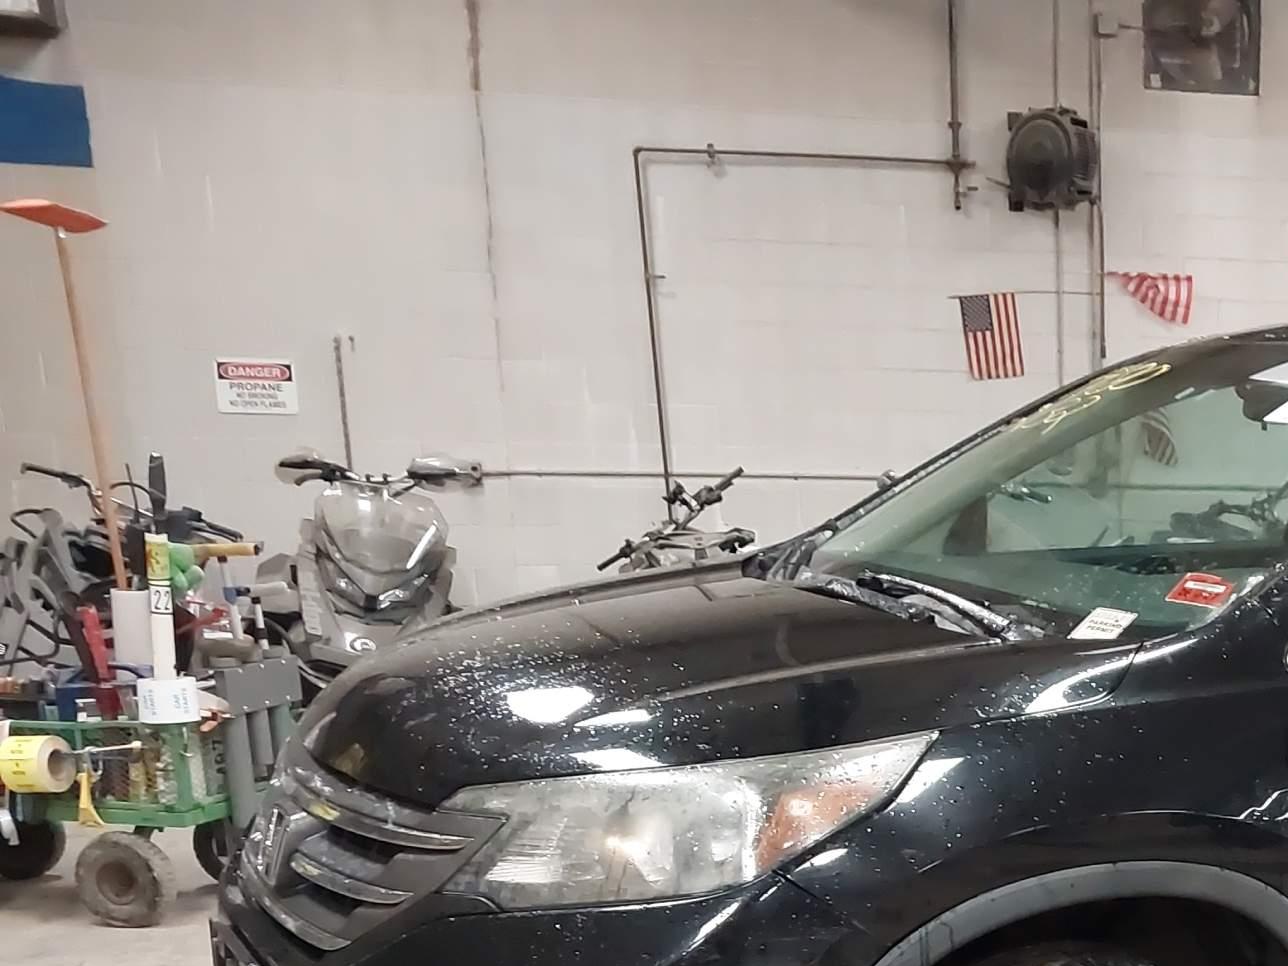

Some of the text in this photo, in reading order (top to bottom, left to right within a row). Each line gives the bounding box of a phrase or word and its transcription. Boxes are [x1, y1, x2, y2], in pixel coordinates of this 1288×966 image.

[227, 366, 281, 378] DANGER
[229, 382, 284, 392] PROPANE
[154, 590, 170, 610] 22
